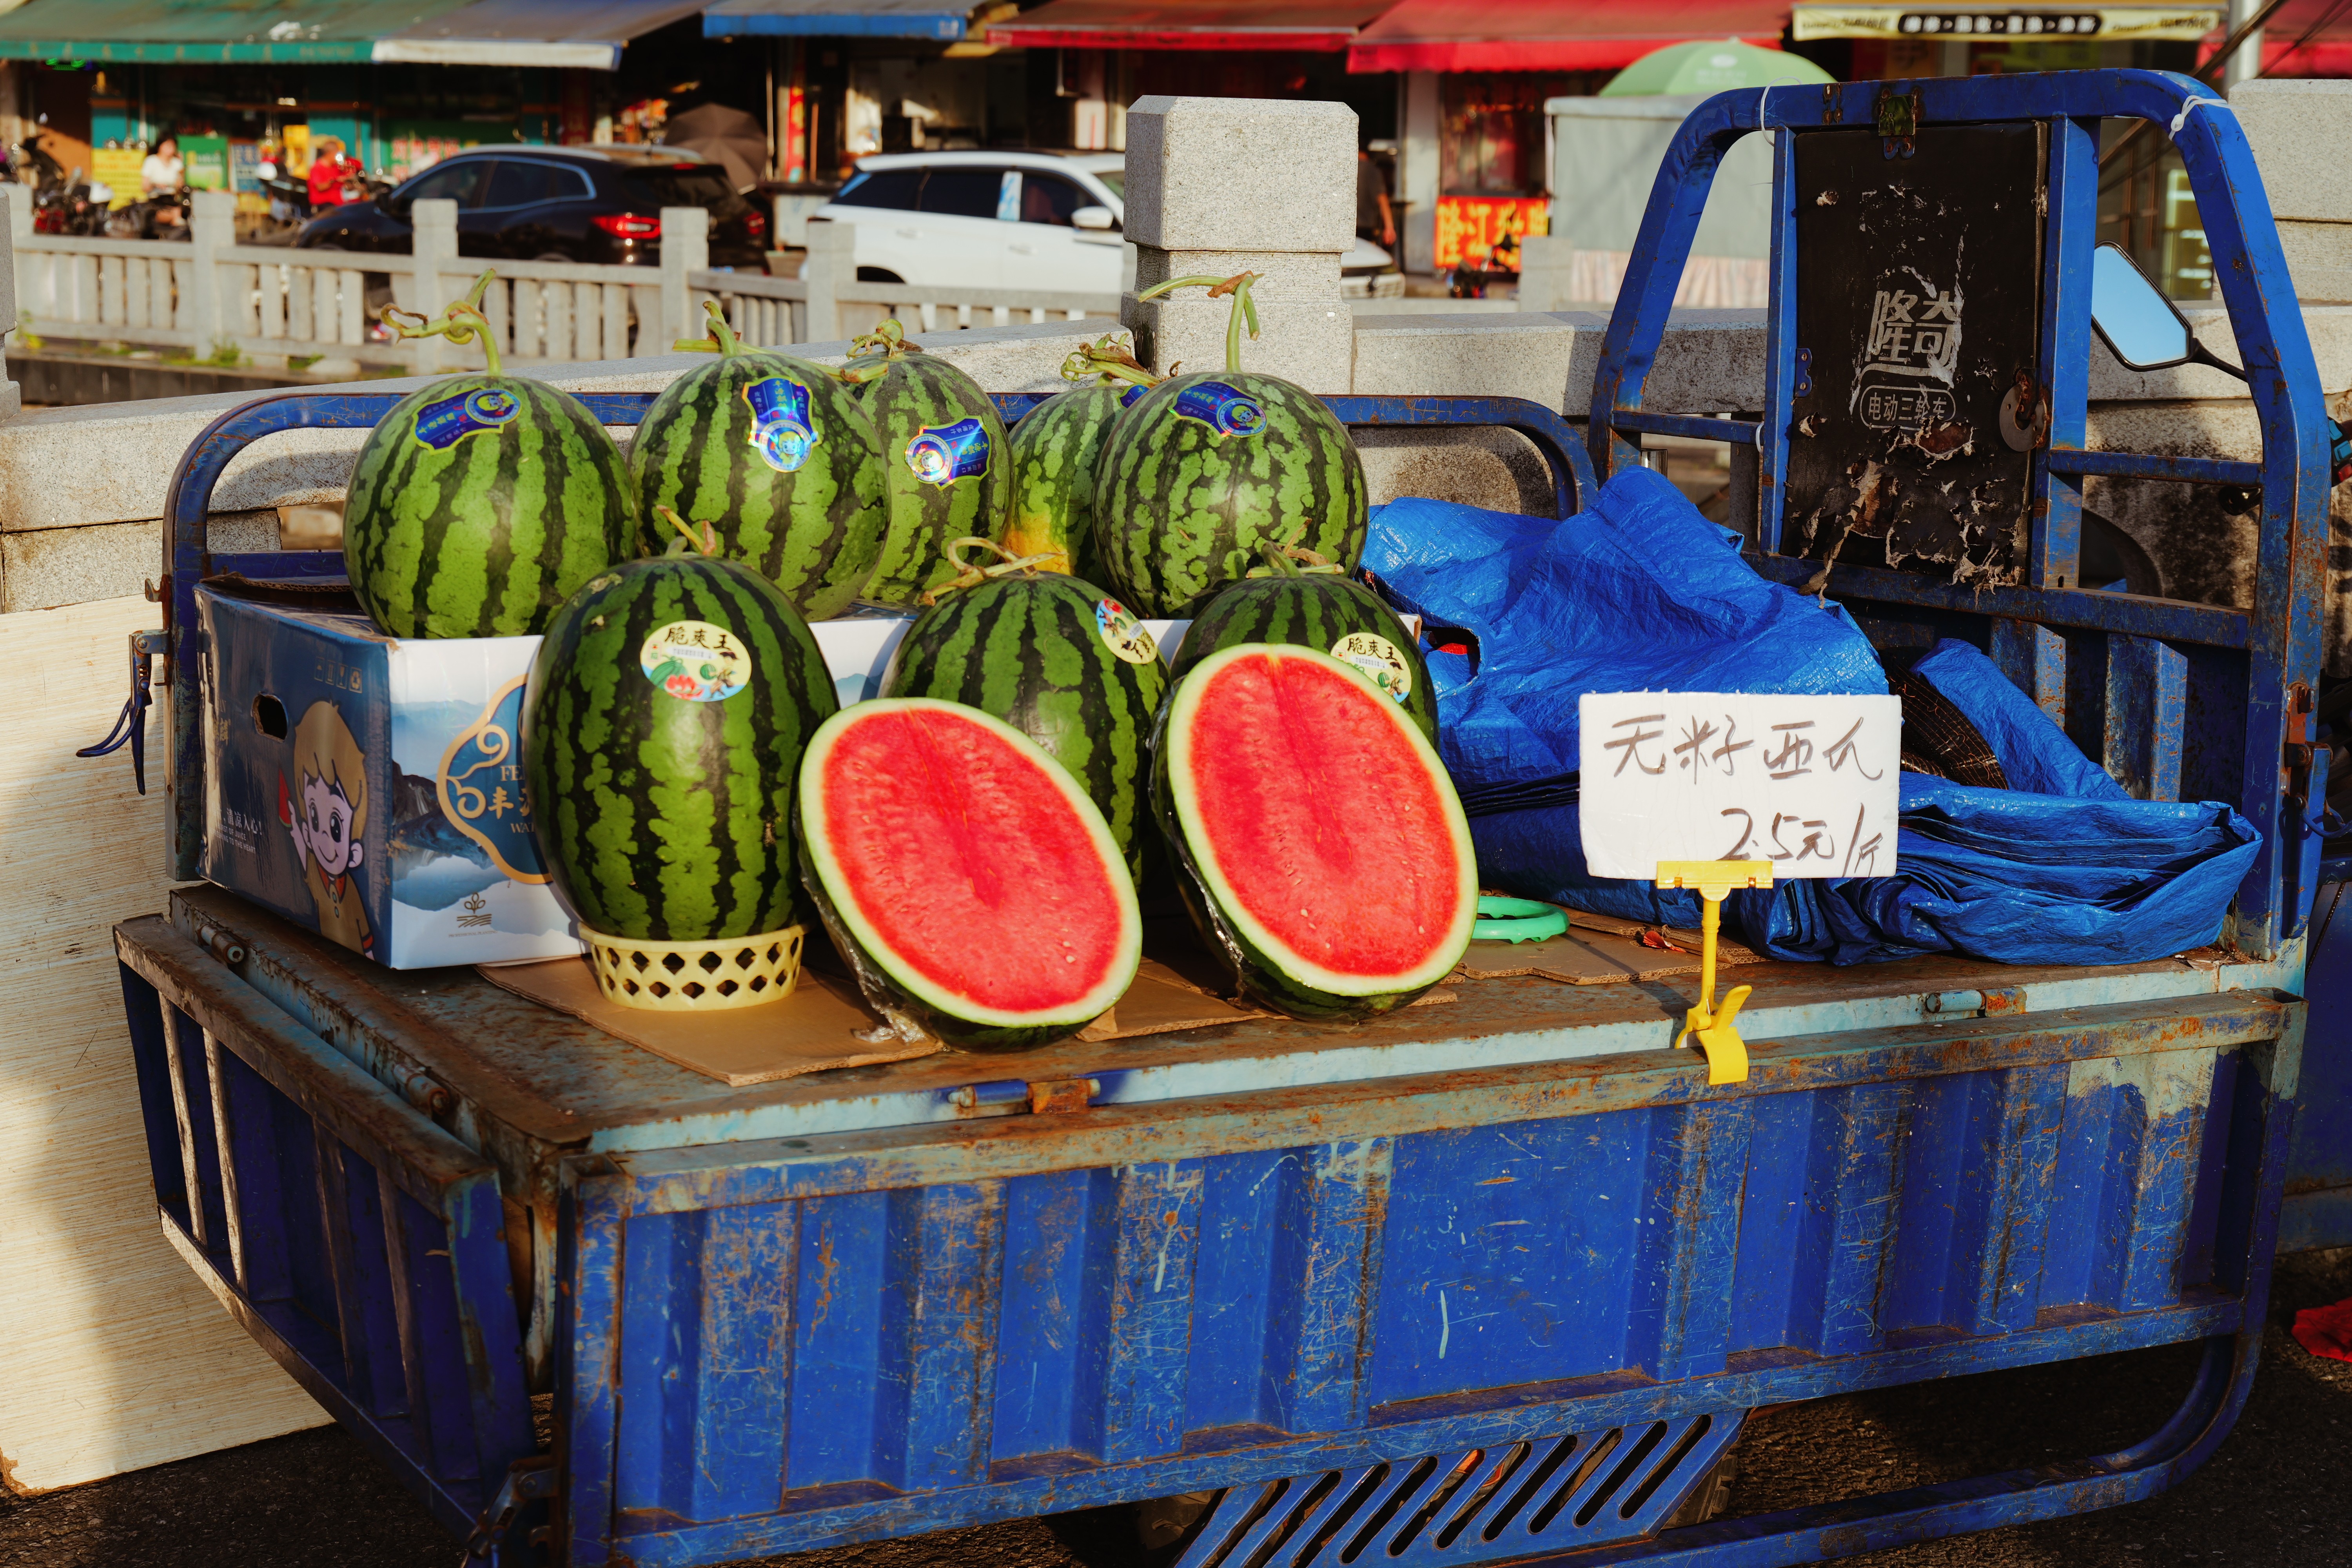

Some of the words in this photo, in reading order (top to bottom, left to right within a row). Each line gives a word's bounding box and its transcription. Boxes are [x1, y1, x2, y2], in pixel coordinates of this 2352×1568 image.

[1868, 392, 1947, 424] 电动三轮车
[664, 626, 732, 650] 脆爽王
[1347, 637, 1398, 662] 脆爽王
[1603, 714, 1883, 784] 无籽西瓜
[500, 765, 526, 782] FE
[229, 827, 234, 835] OF
[235, 831, 247, 841] JUICE
[229, 837, 234, 845] TO
[235, 838, 243, 849] THE
[243, 844, 256, 854] HEART
